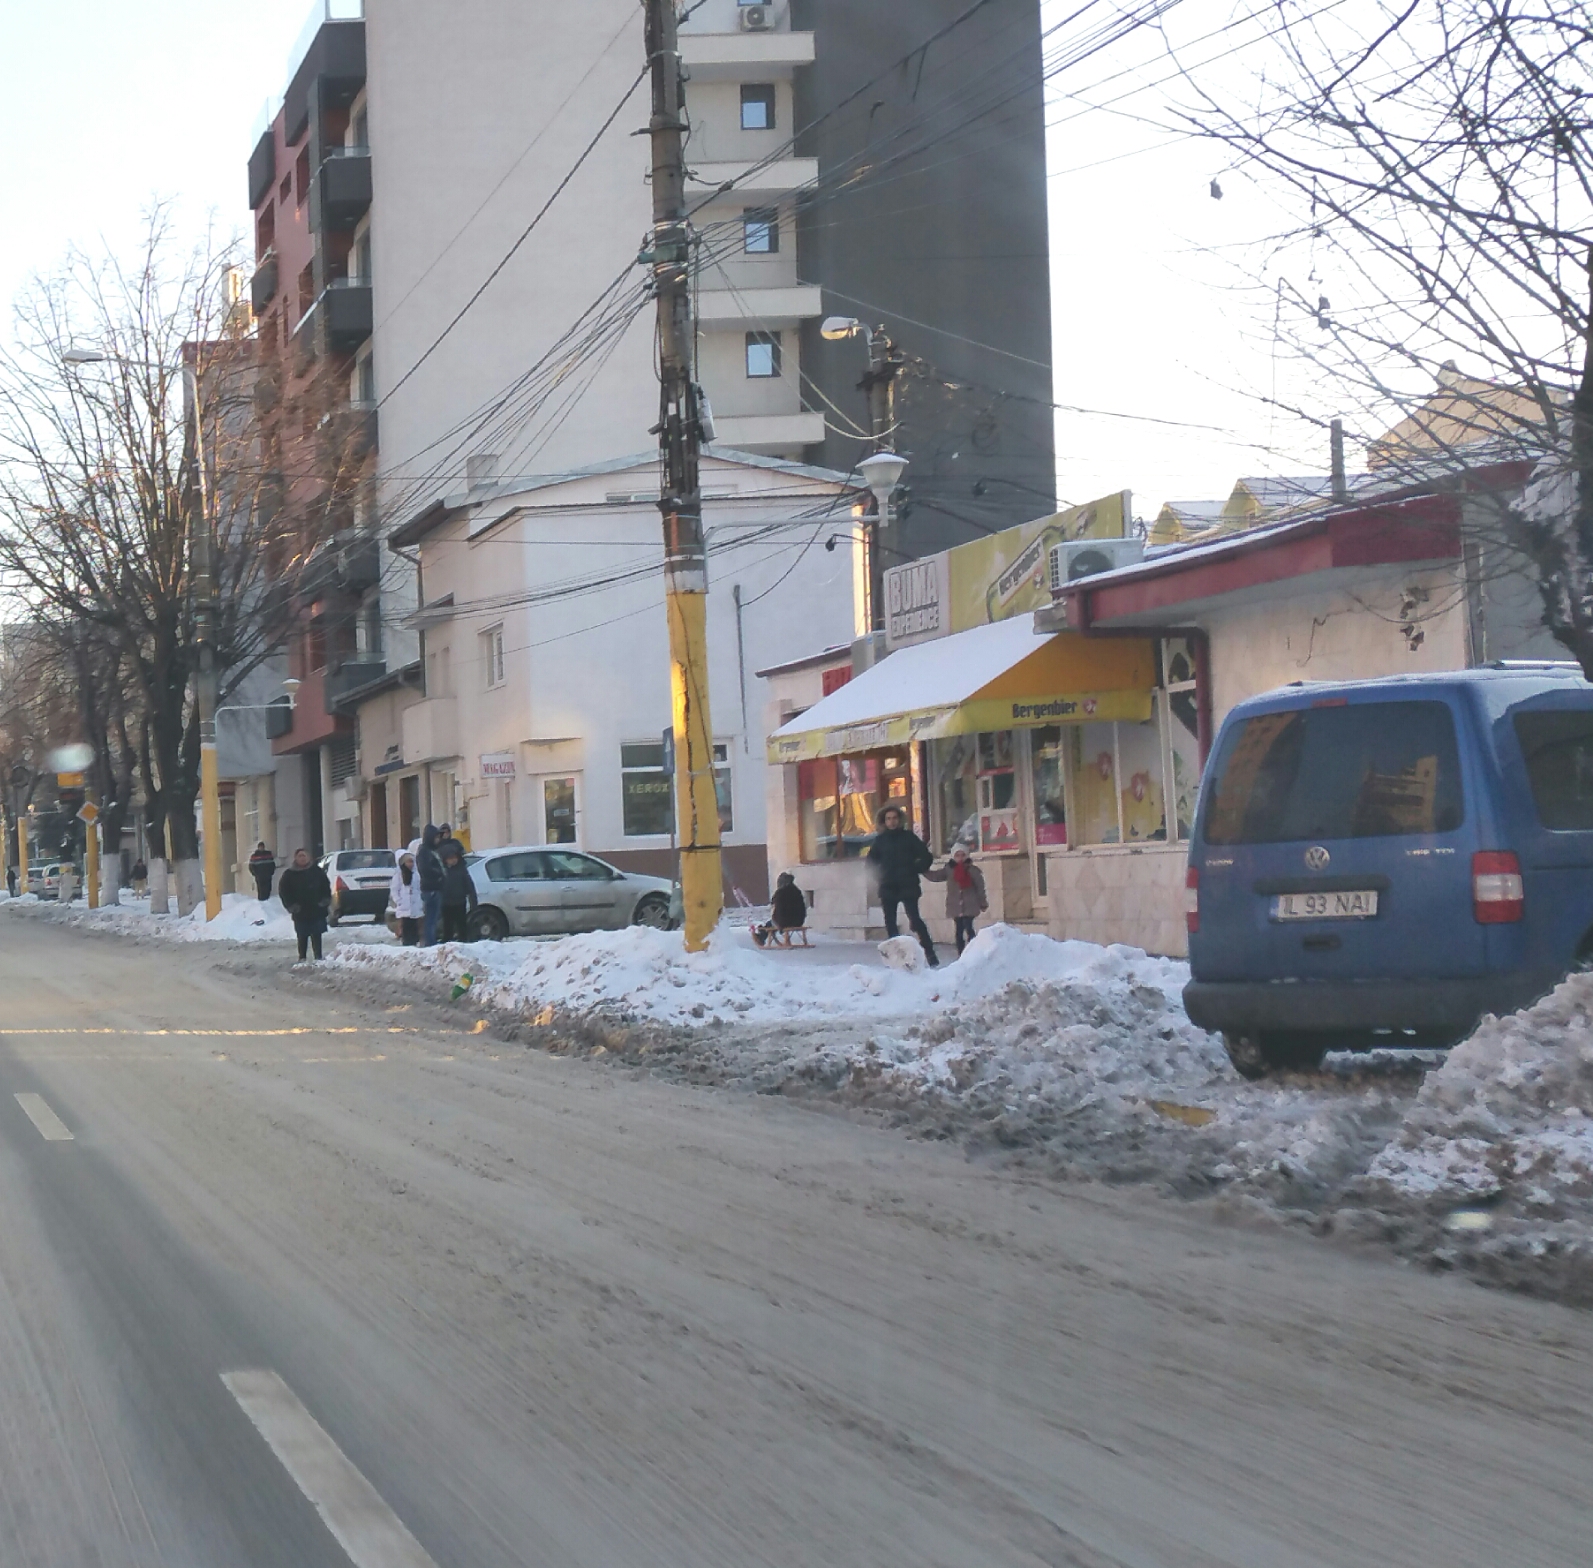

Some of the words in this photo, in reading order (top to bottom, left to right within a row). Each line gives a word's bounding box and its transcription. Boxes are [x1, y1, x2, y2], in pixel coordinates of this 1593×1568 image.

[889, 561, 938, 615] BUMA
[1012, 698, 1078, 720] Bergenbier
[628, 783, 670, 794] XEROX
[1283, 896, 1299, 915] IL
[1305, 895, 1327, 915] 93
